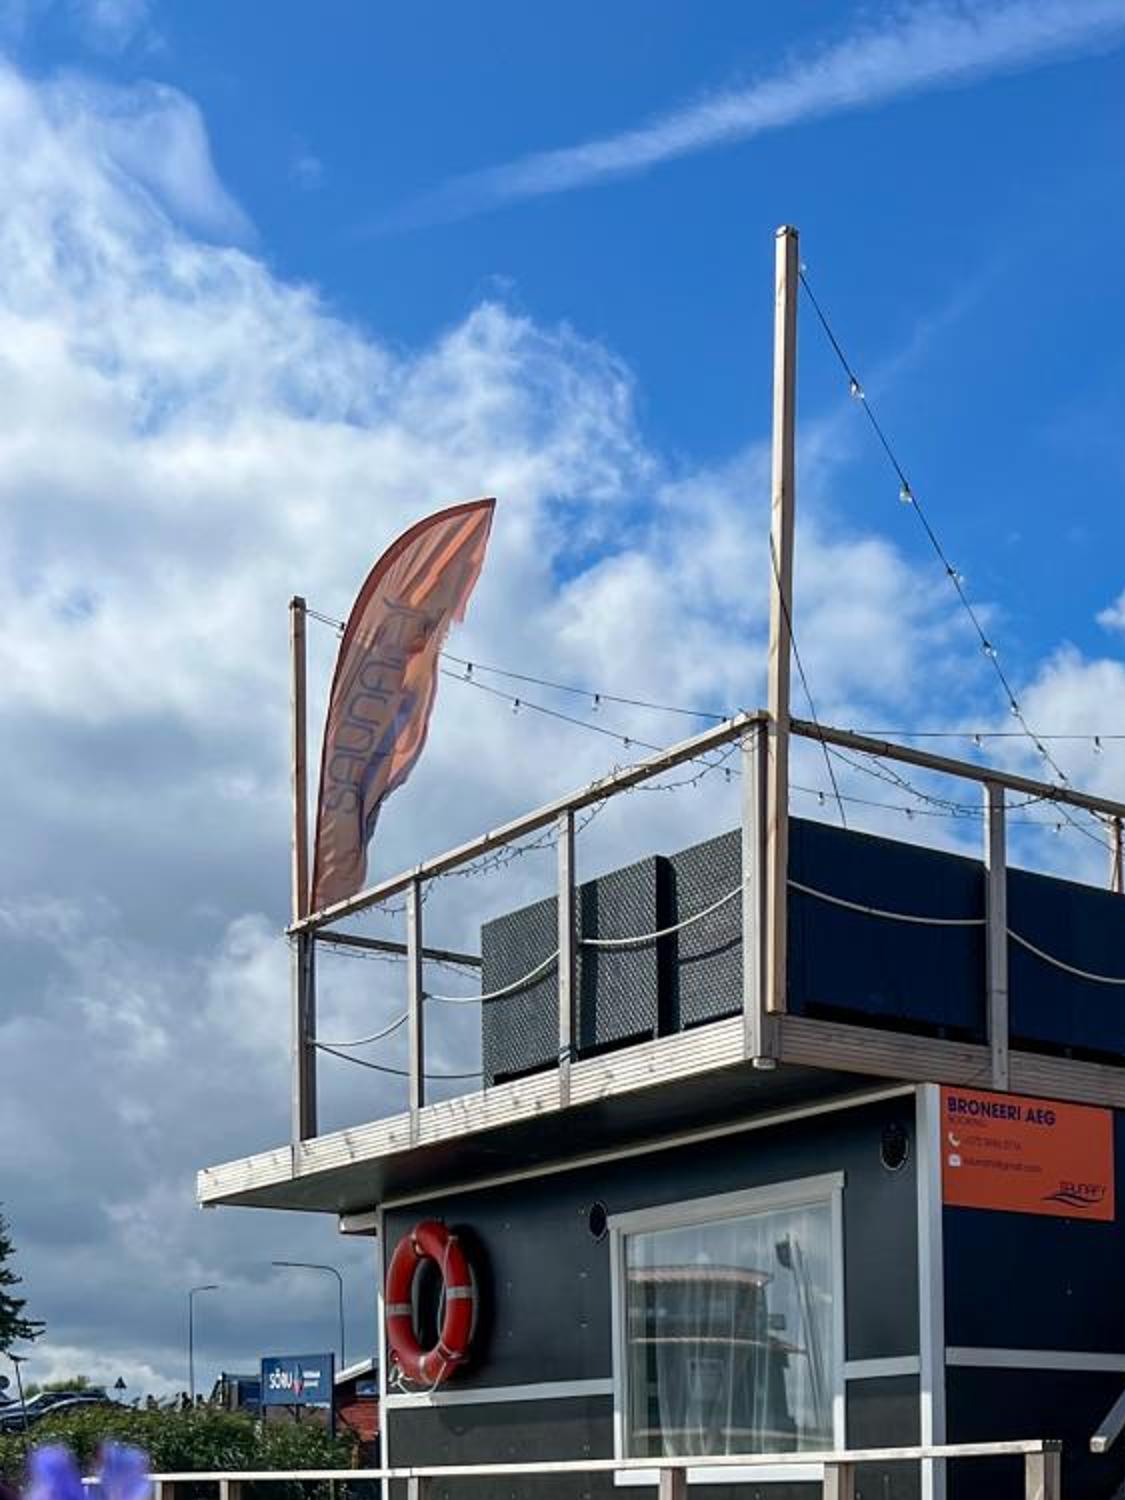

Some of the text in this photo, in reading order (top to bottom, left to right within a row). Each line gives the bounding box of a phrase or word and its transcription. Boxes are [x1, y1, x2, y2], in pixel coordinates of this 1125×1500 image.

[948, 1096, 1056, 1126] BRONEERI AEG
[268, 1367, 293, 1390] SÕRU
